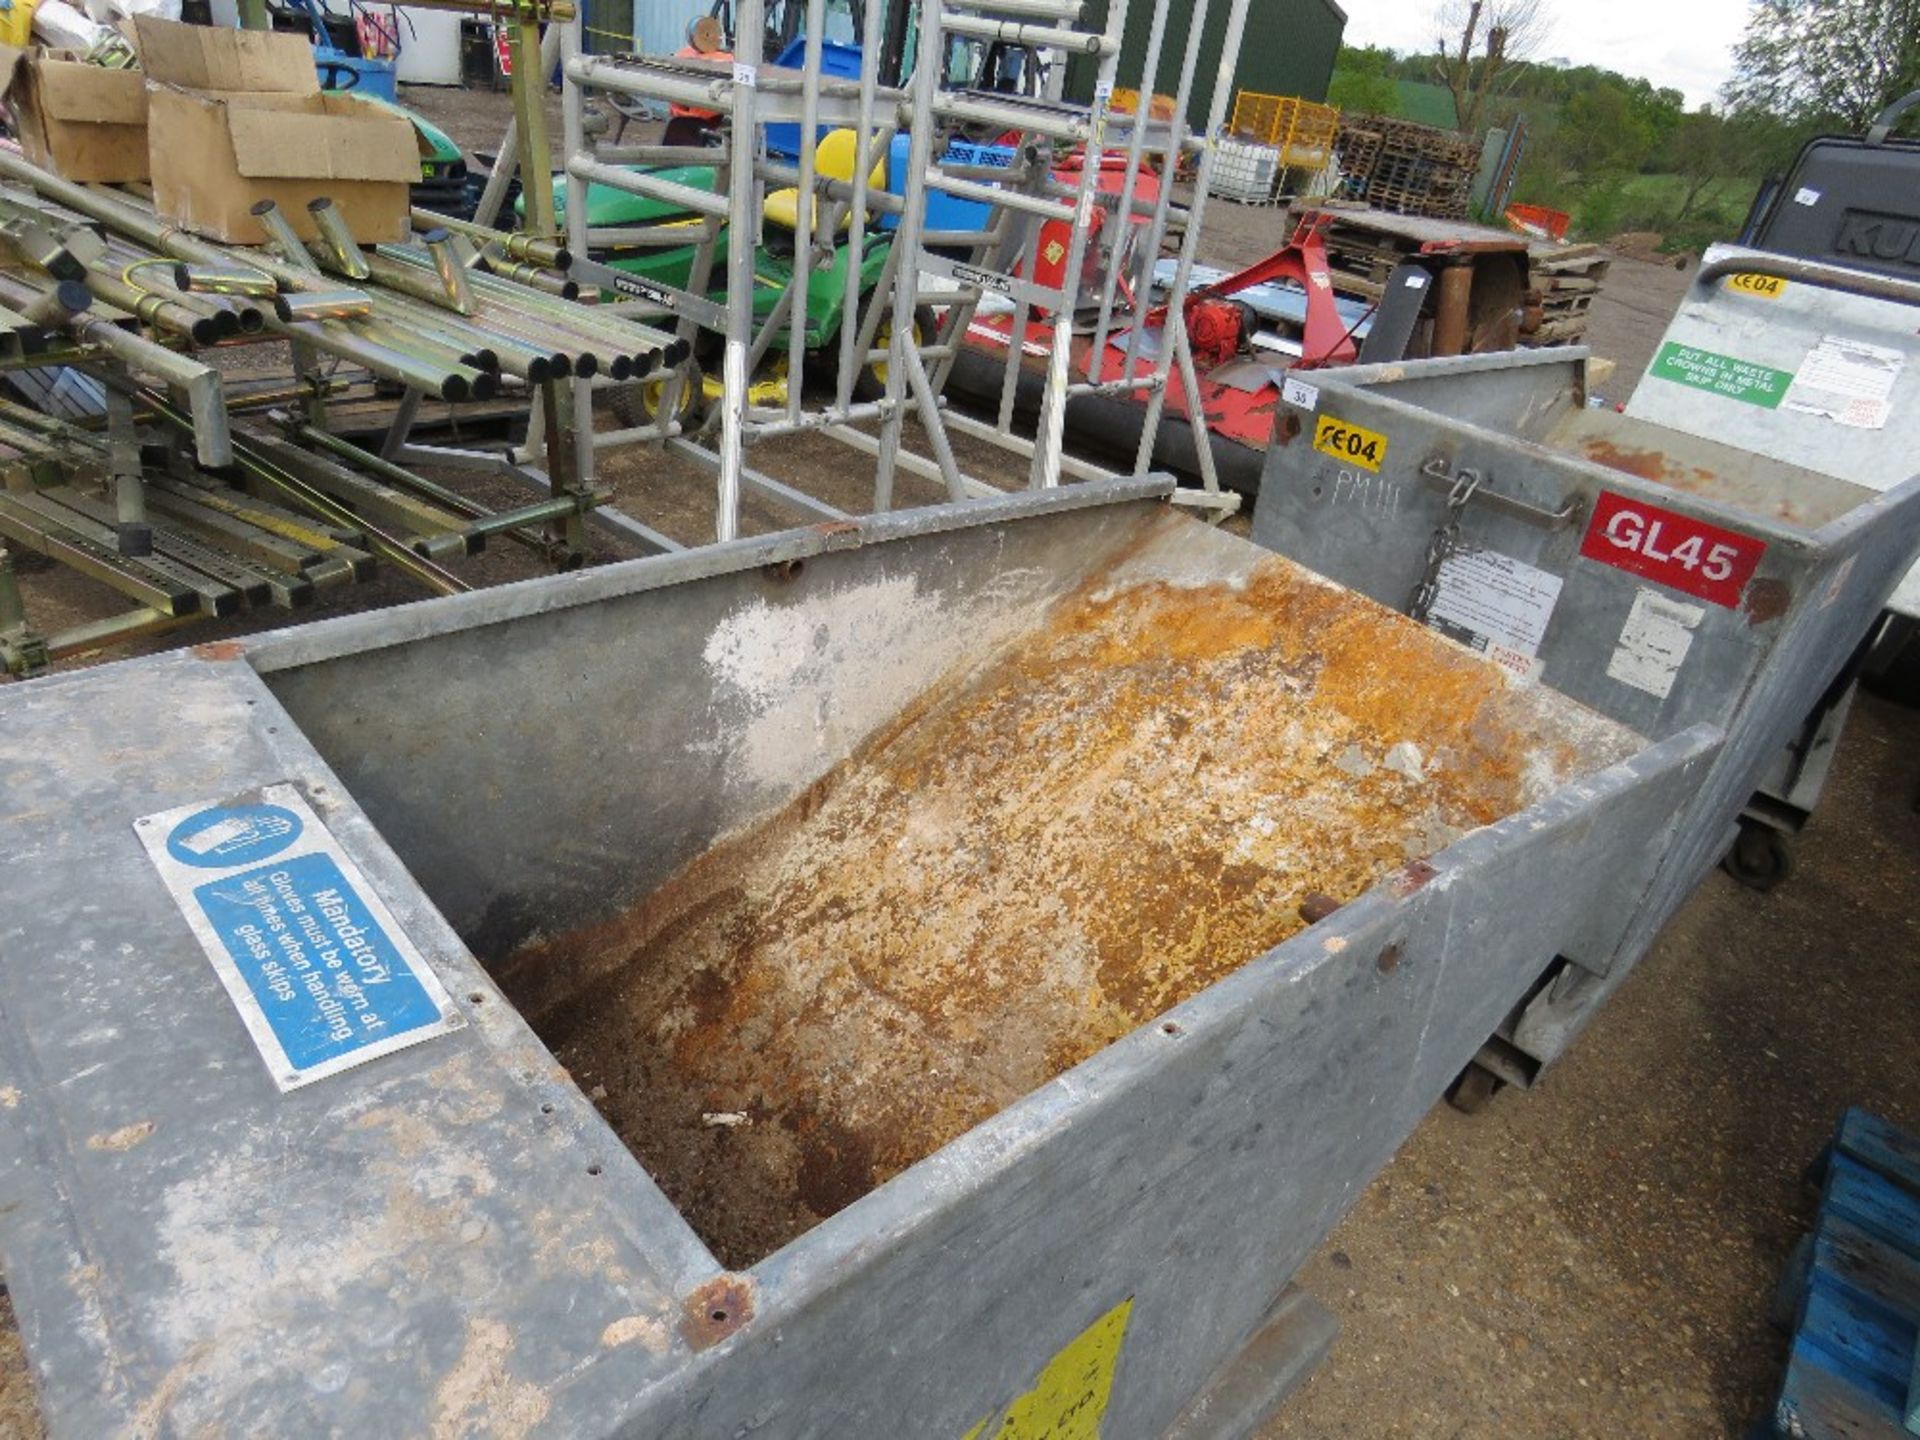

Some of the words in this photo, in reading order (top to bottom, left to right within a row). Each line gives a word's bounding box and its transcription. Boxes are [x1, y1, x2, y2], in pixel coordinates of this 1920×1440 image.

[1665, 356, 1718, 377] CROWNS
[1719, 371, 1735, 381] IN
[1735, 375, 1776, 393] METAL
[1677, 348, 1701, 362] PUT
[1704, 356, 1727, 370] ALL
[1732, 363, 1775, 381] WASTE
[1684, 372, 1713, 385] SKIP
[1713, 380, 1747, 395] ONLY
[1605, 510, 1738, 581] GL45
[234, 923, 271, 962] glass
[261, 959, 297, 1003] skips
[243, 876, 262, 902] all
[254, 896, 287, 933] times
[277, 931, 312, 971] when
[302, 965, 354, 1042] handling
[269, 871, 303, 915] Gloves
[296, 914, 333, 950] must
[320, 949, 343, 969] be
[335, 969, 371, 1009] worn
[361, 1010, 387, 1031] at
[312, 888, 392, 985] Mandatory
